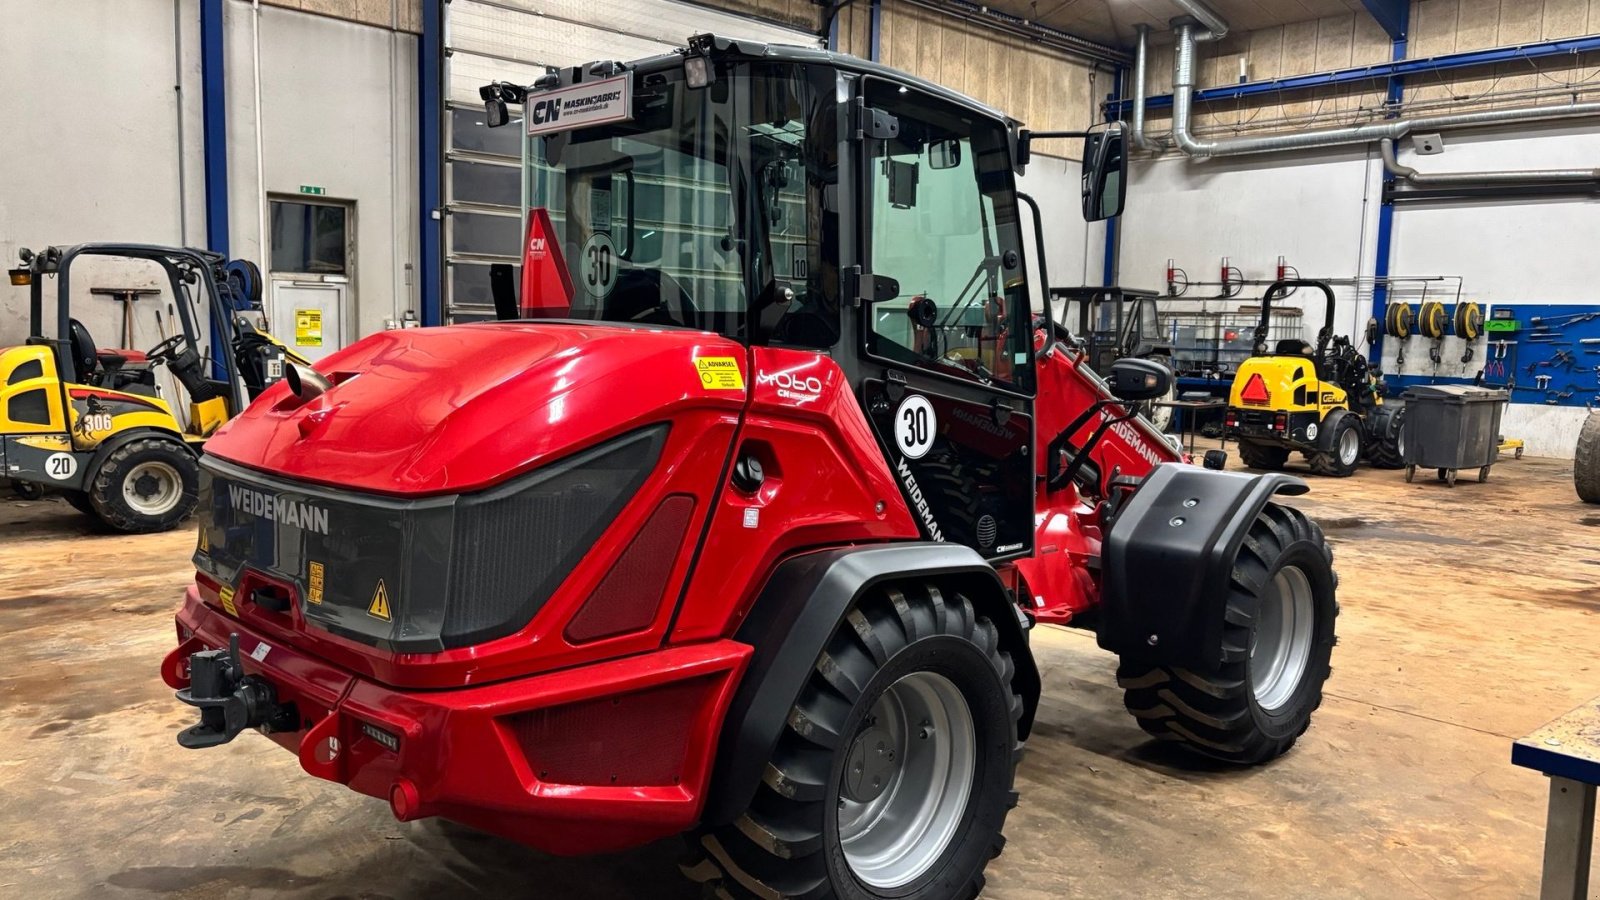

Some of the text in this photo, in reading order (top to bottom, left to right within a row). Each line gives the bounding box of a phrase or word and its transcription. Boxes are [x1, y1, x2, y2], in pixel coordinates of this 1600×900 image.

[533, 98, 562, 125] CN
[530, 238, 545, 250] CN
[587, 244, 611, 287] 30
[795, 259, 806, 277] 10
[777, 389, 791, 399] CN
[84, 414, 113, 432] 306
[902, 405, 929, 448] 30
[1308, 427, 1316, 438] 20
[52, 457, 71, 475] 20
[896, 455, 947, 543] WEIDEMAN
[228, 484, 329, 536] WEIDEMANN
